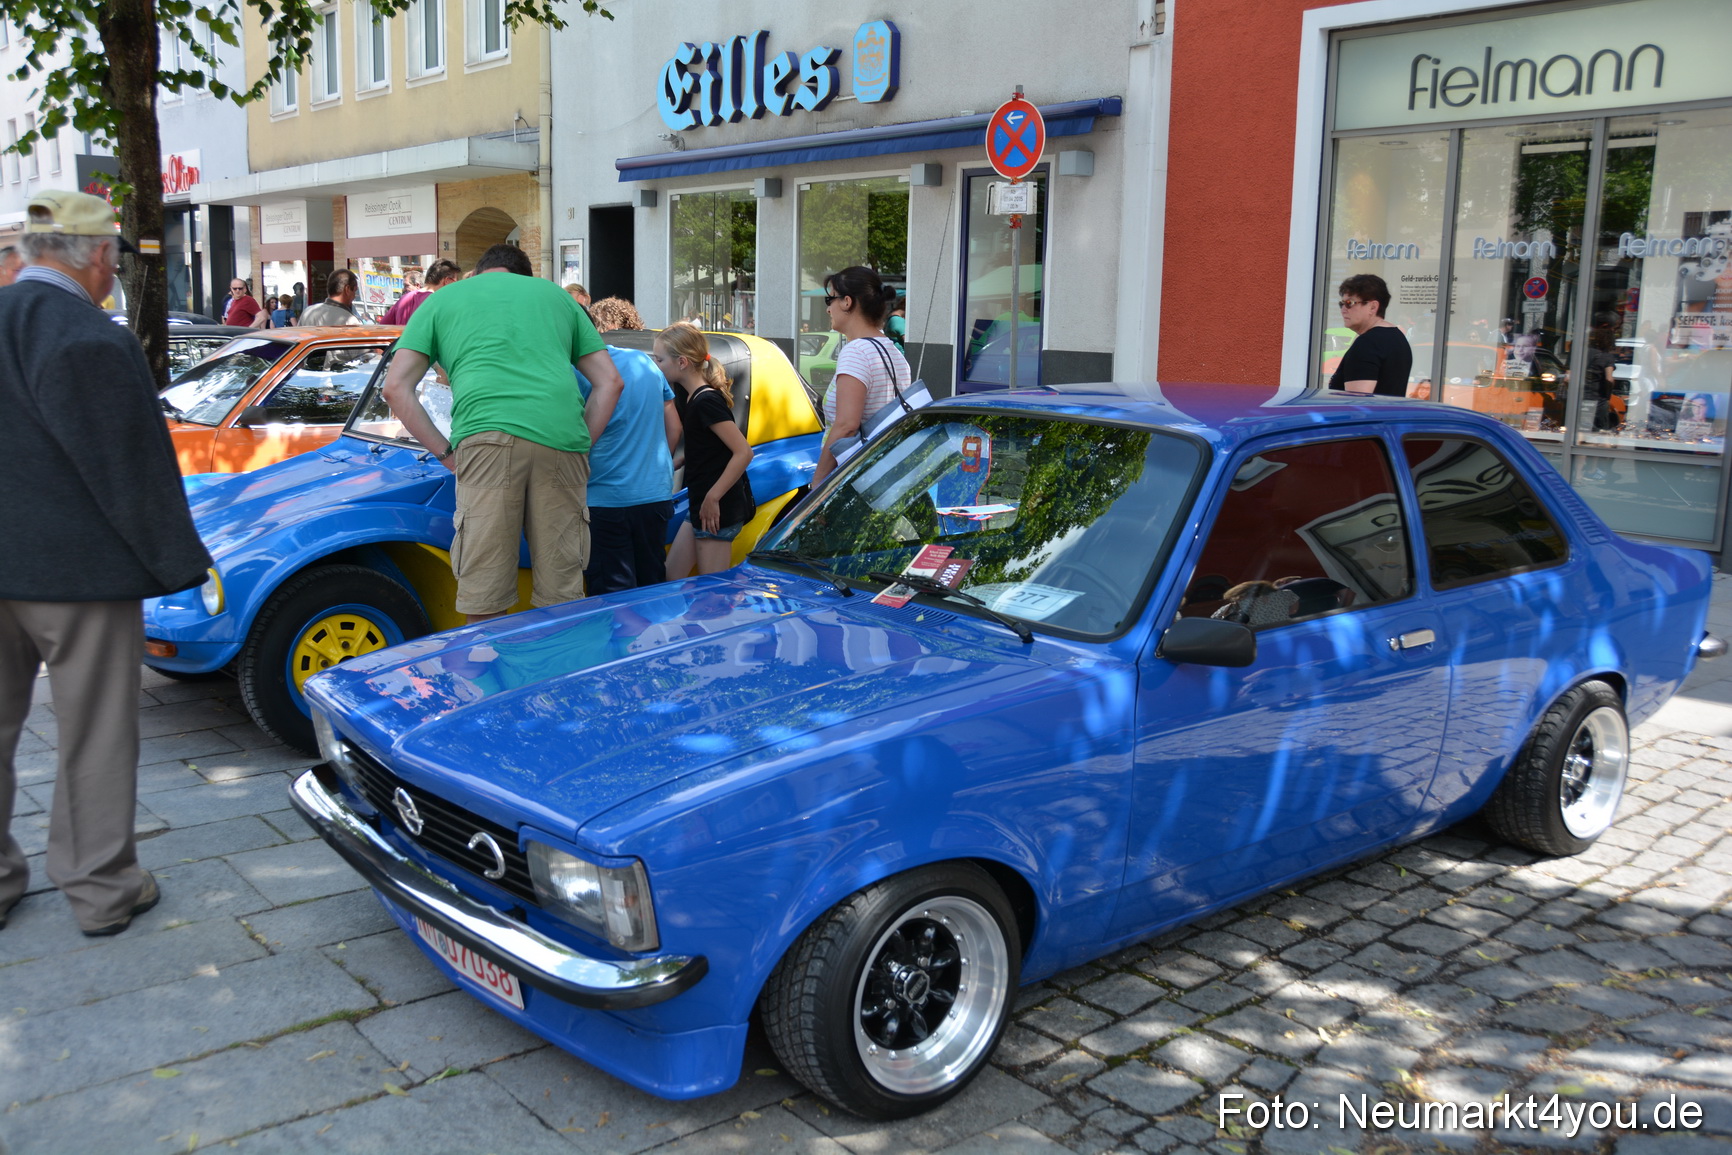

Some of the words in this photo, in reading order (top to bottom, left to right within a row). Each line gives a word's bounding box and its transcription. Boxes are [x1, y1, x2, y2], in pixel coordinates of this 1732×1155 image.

[657, 30, 840, 131] Eilles
[1408, 43, 1664, 110] fielmann
[365, 201, 388, 214] Reissinger
[389, 199, 402, 211] Optik
[389, 213, 412, 226] CENTRUM
[1347, 238, 1419, 260] fielmann
[1473, 236, 1556, 260] fielmann
[1618, 231, 1717, 259] fielmann
[1011, 591, 1049, 606] 277
